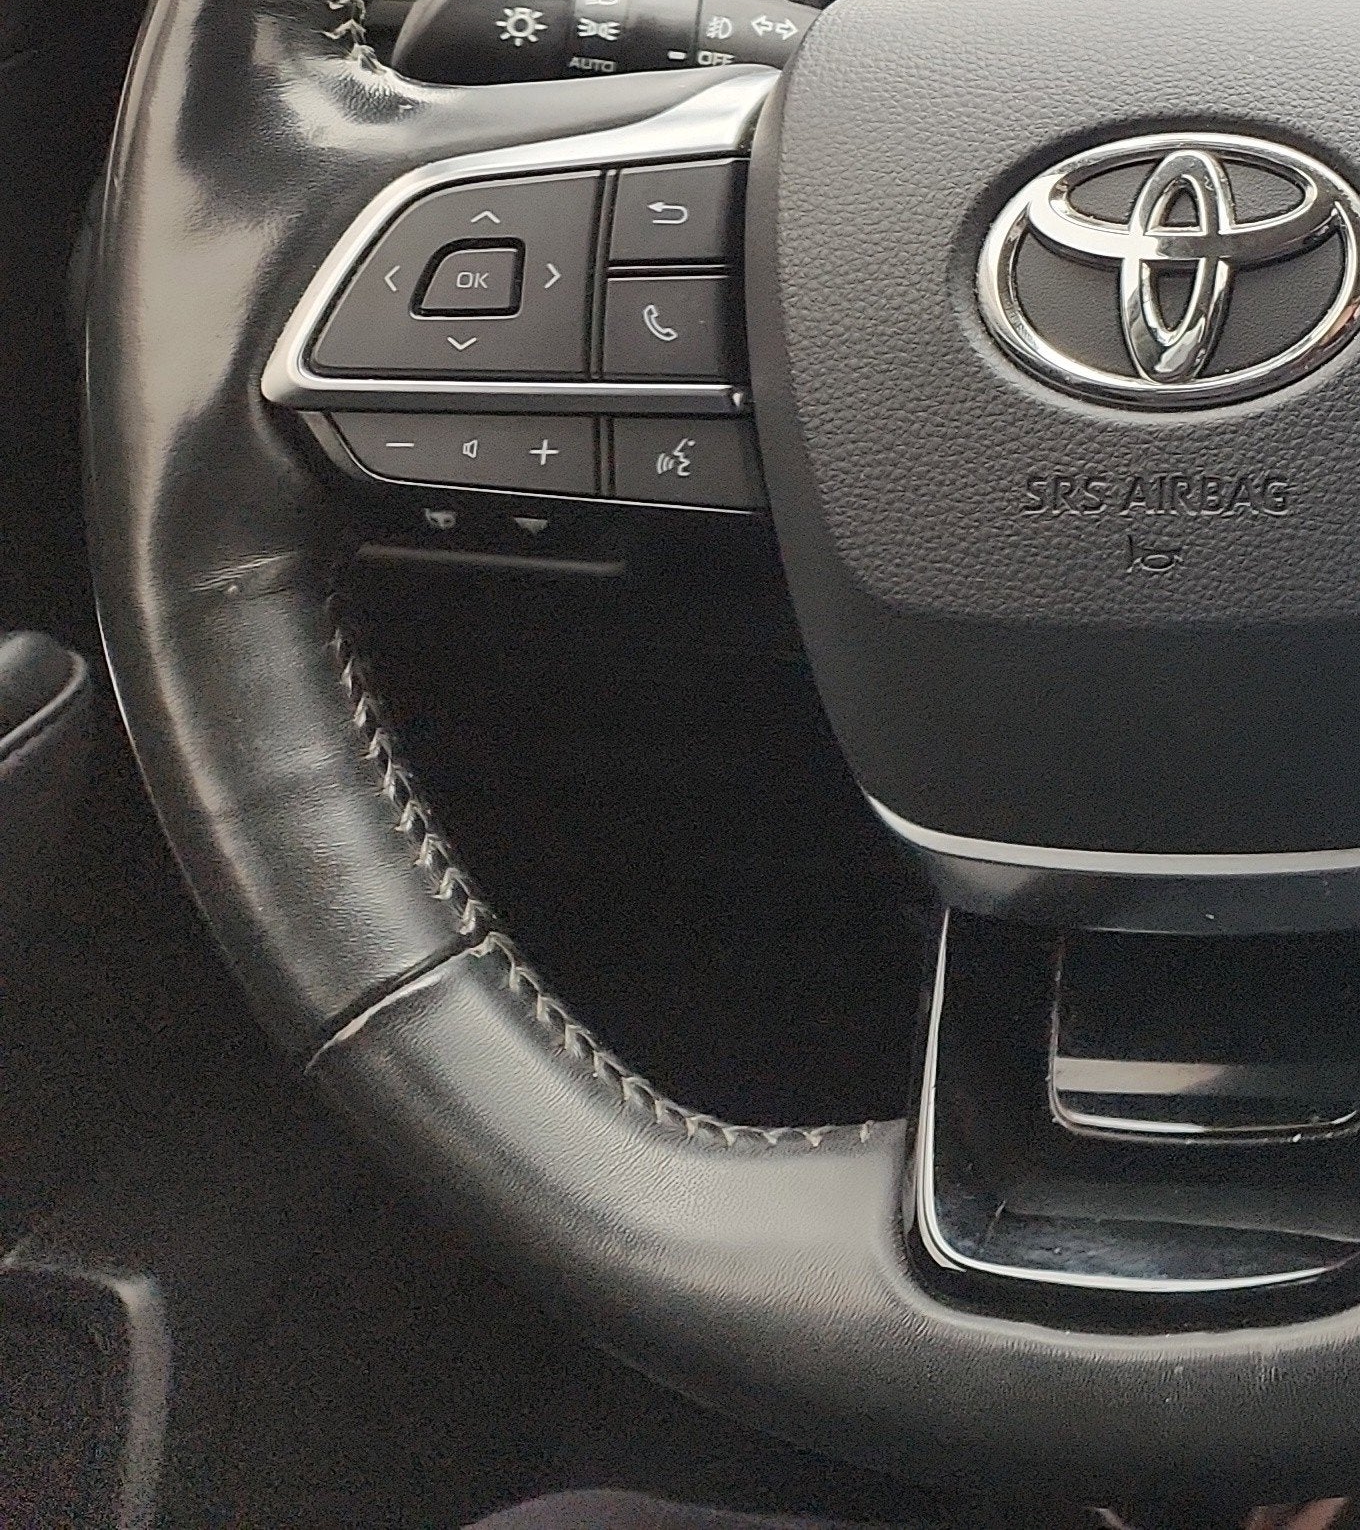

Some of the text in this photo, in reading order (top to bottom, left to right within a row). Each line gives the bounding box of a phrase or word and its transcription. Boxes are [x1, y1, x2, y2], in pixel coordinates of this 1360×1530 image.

[569, 56, 616, 73] AUTO
[699, 50, 735, 66] OFF
[456, 271, 488, 289] OK
[1022, 474, 1292, 517] SRS AIRBAG
